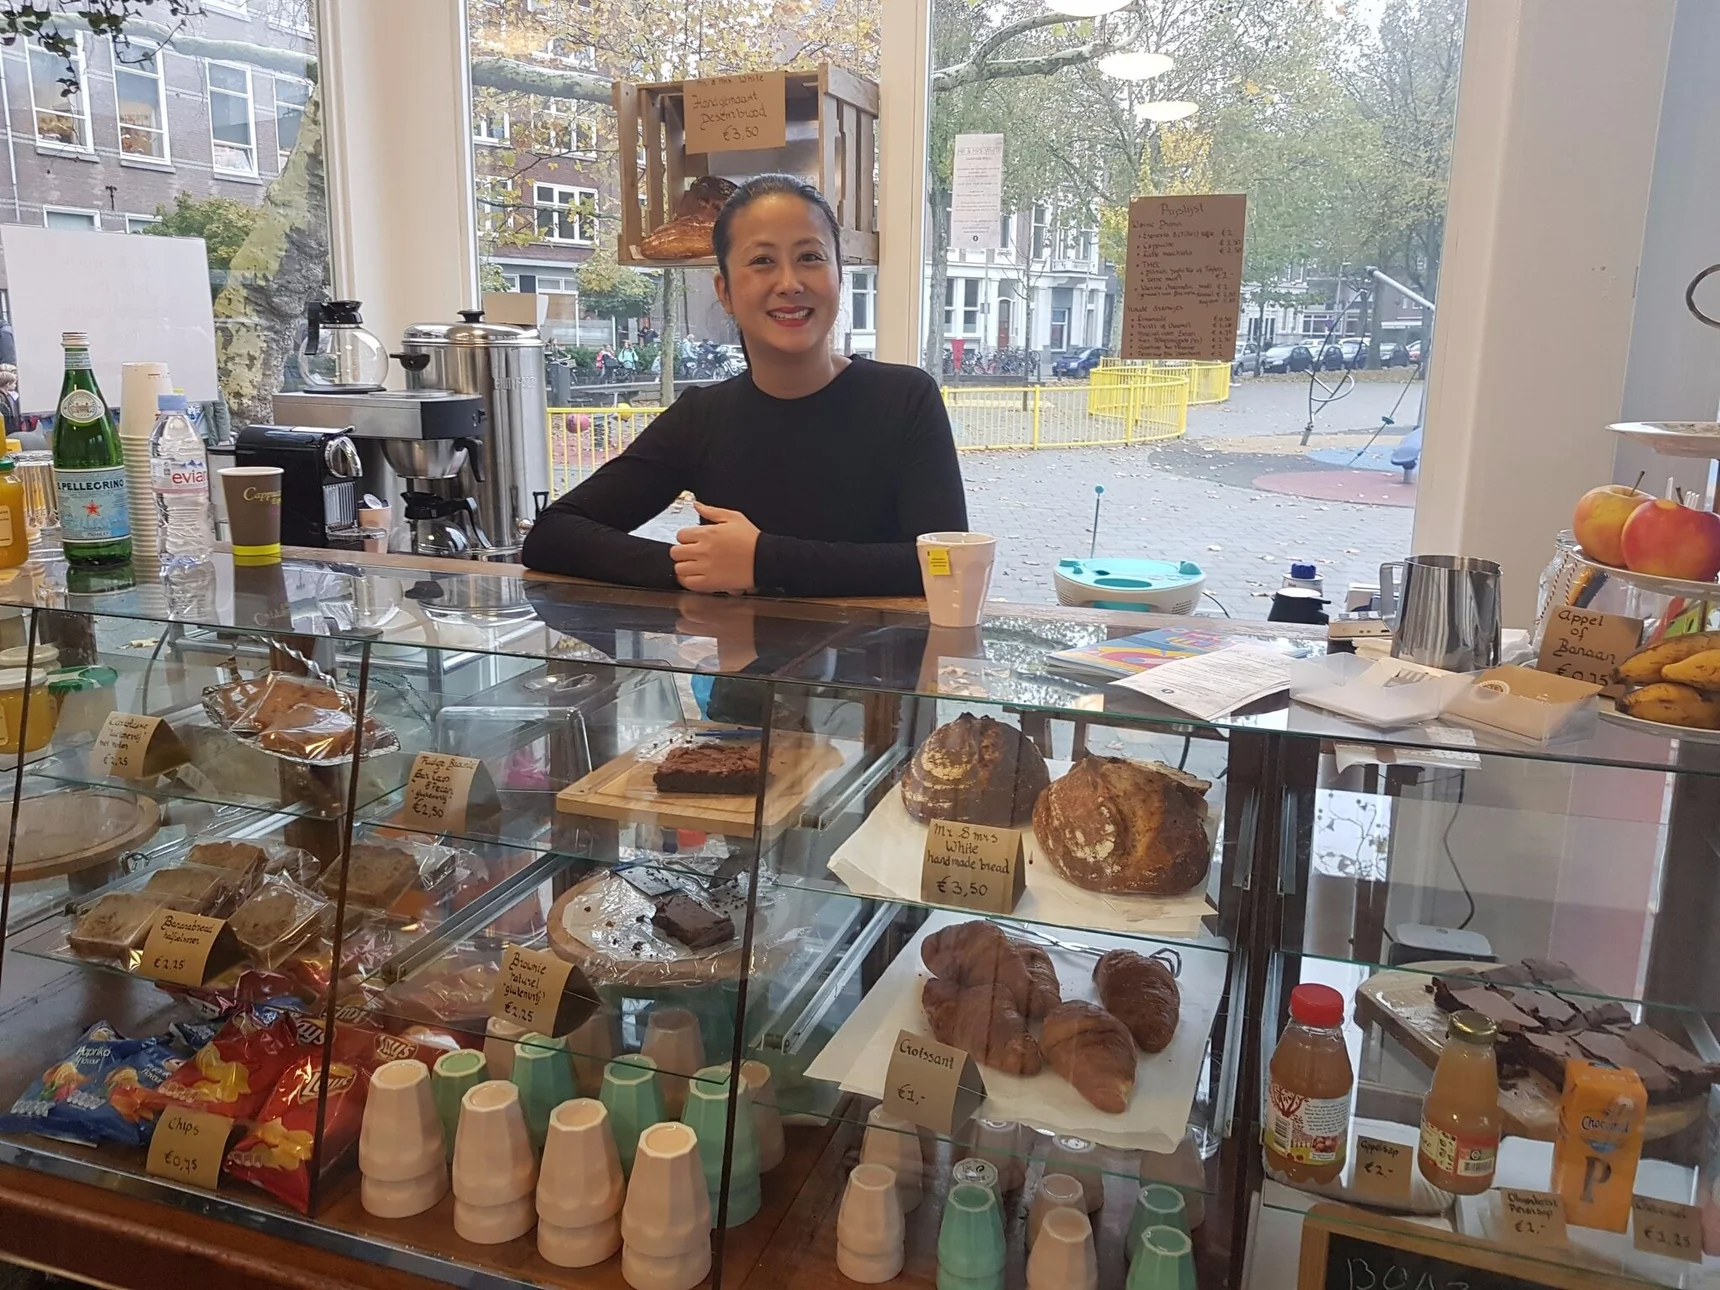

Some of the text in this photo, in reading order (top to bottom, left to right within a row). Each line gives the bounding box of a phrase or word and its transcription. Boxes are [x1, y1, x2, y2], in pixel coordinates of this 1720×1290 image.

[1570, 626, 1589, 641] of
[1552, 637, 1616, 665] Banaan
[411, 798, 444, 819] €2,50
[933, 823, 953, 838] Mr
[945, 840, 979, 855] White
[927, 850, 1010, 874] handmade bread
[936, 875, 988, 897] €3,50
[508, 951, 547, 975] Brownie
[899, 1038, 955, 1070] Croissant
[168, 1117, 199, 1136] Chips
[164, 1148, 198, 1175] €0,75
[1346, 1257, 1470, 1290] BOA
